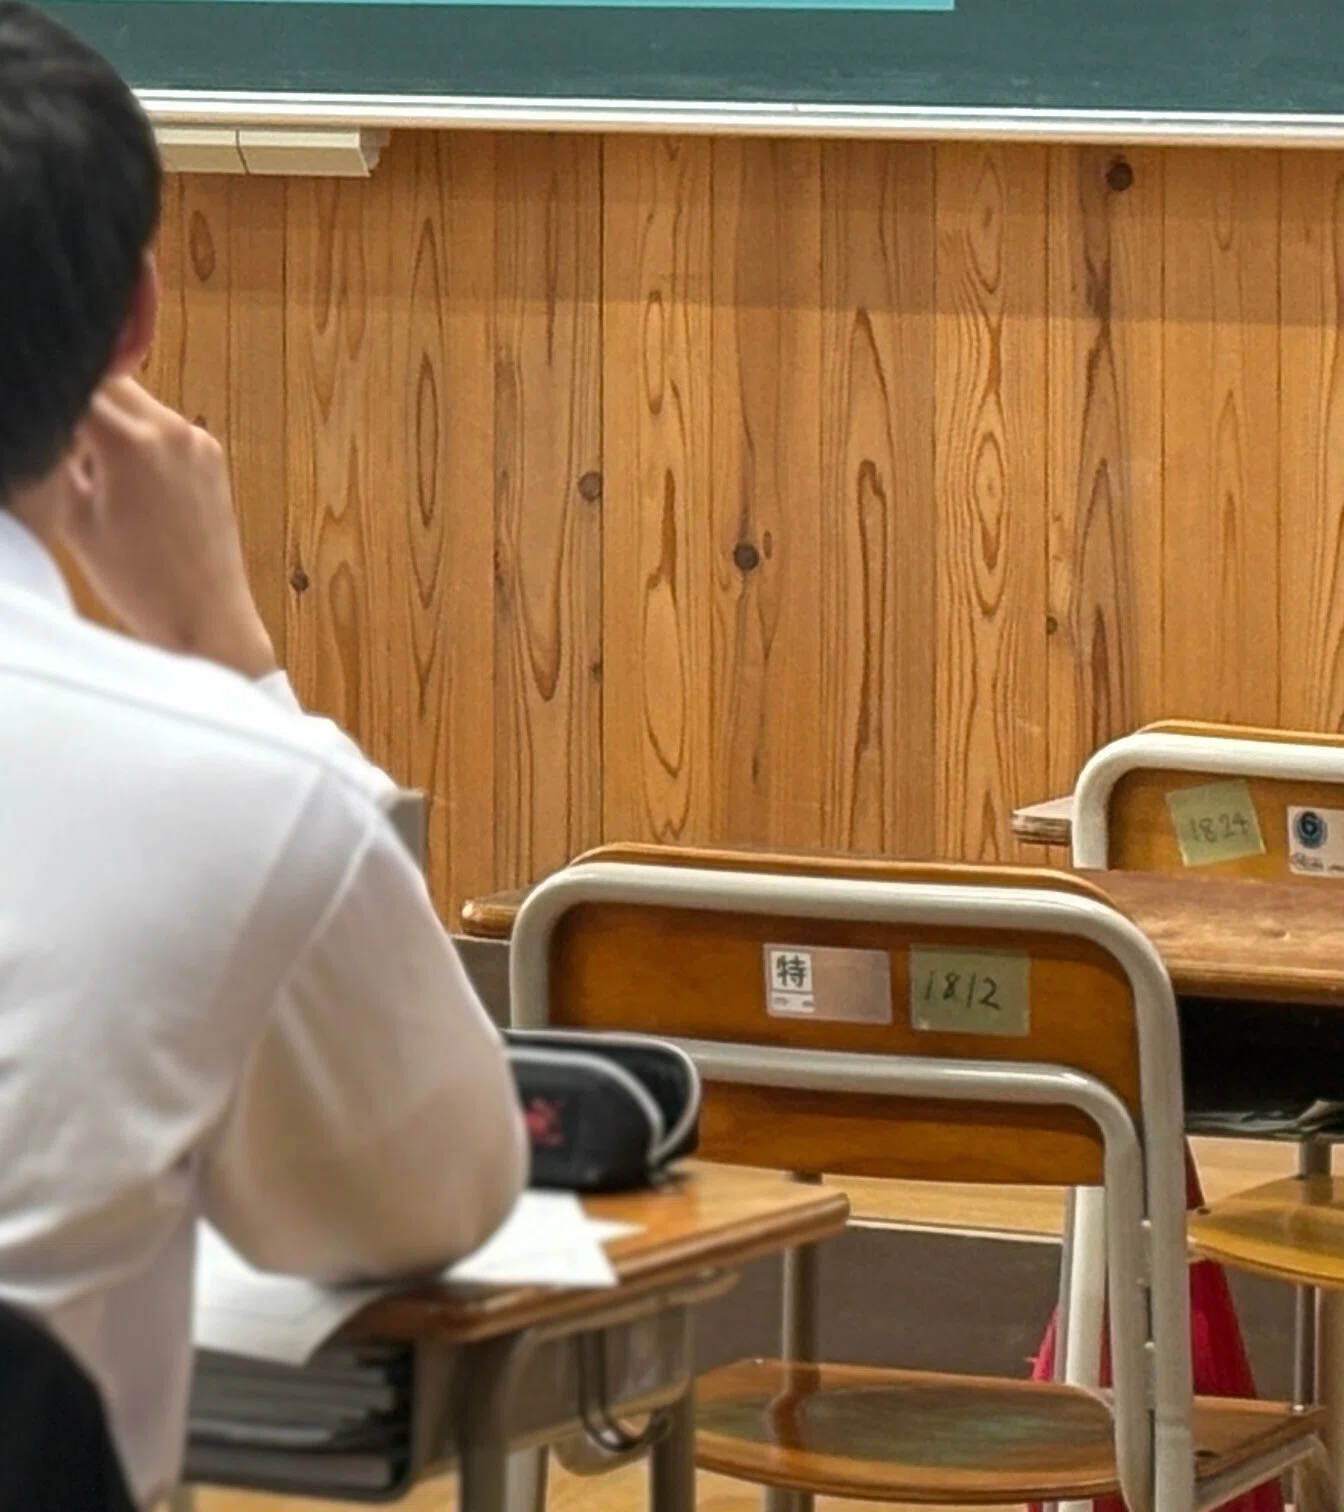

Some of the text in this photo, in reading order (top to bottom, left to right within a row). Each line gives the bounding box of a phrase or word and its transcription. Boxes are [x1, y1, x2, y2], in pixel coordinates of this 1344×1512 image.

[1188, 811, 1249, 844] 1824
[776, 954, 808, 988] 特
[924, 969, 1001, 1010] 1812
